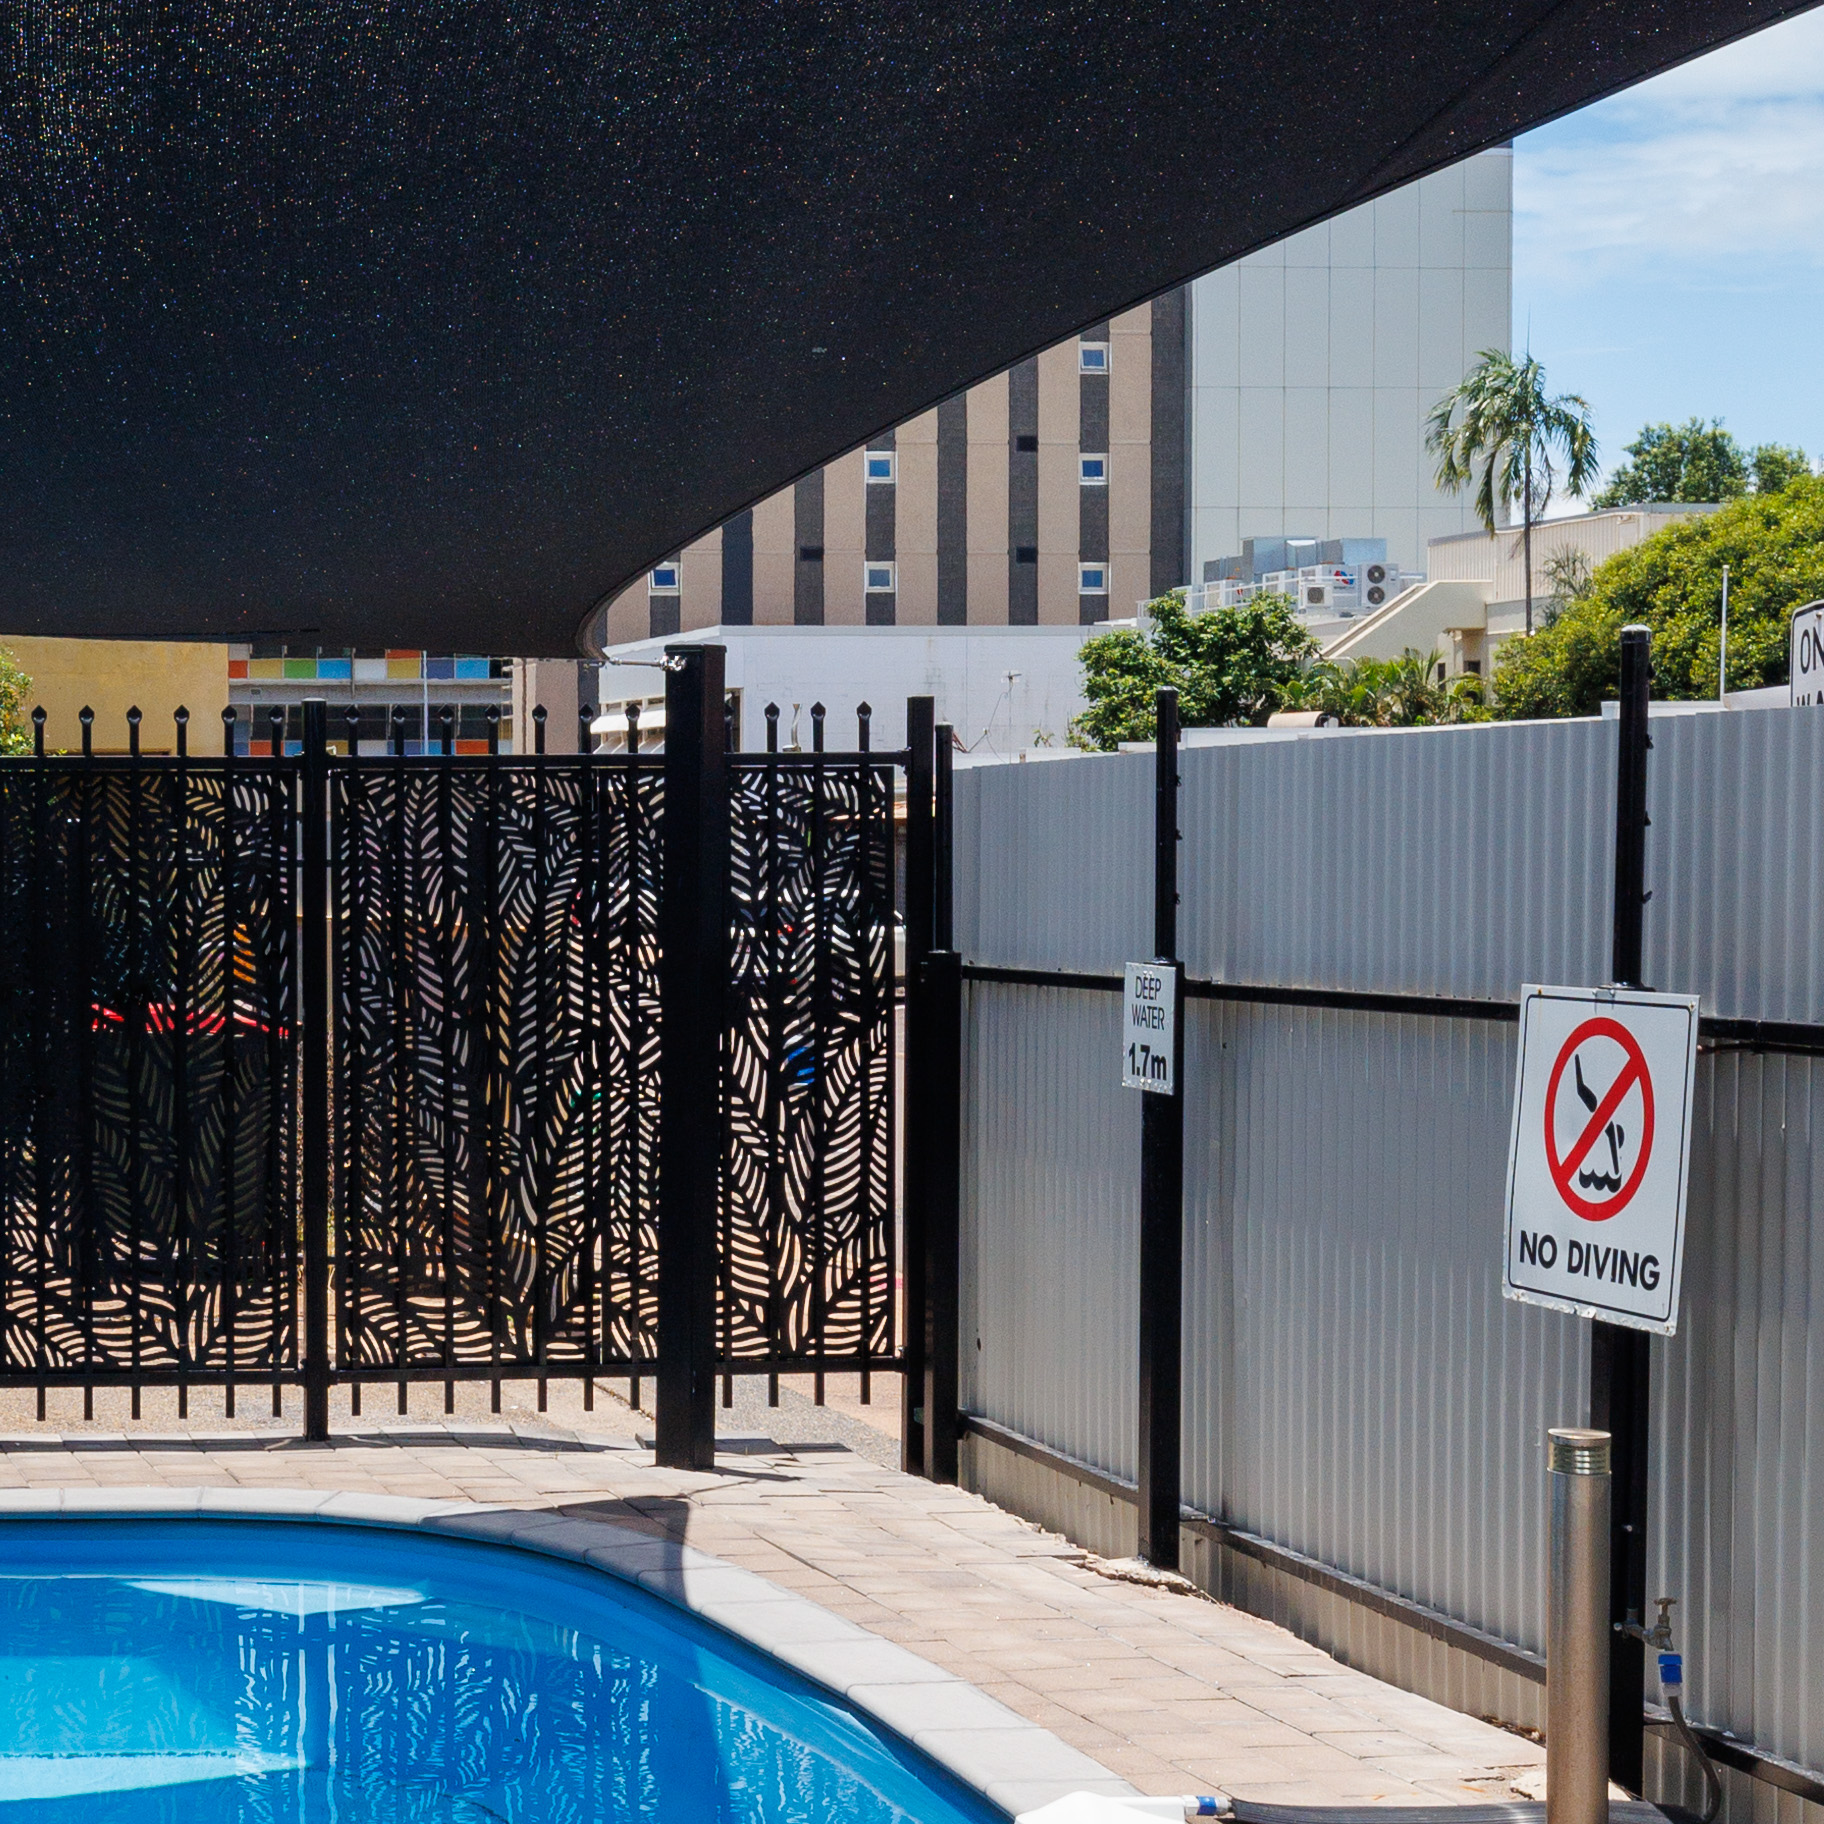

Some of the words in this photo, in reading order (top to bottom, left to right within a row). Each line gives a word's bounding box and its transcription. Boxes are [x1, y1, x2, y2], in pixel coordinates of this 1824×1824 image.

[1135, 976, 1162, 1001] DEEP
[1132, 1003, 1165, 1031] WATER
[1128, 1042, 1167, 1081] 1.7m
[1519, 1230, 1558, 1269] NO
[1567, 1239, 1660, 1291] DIVING
